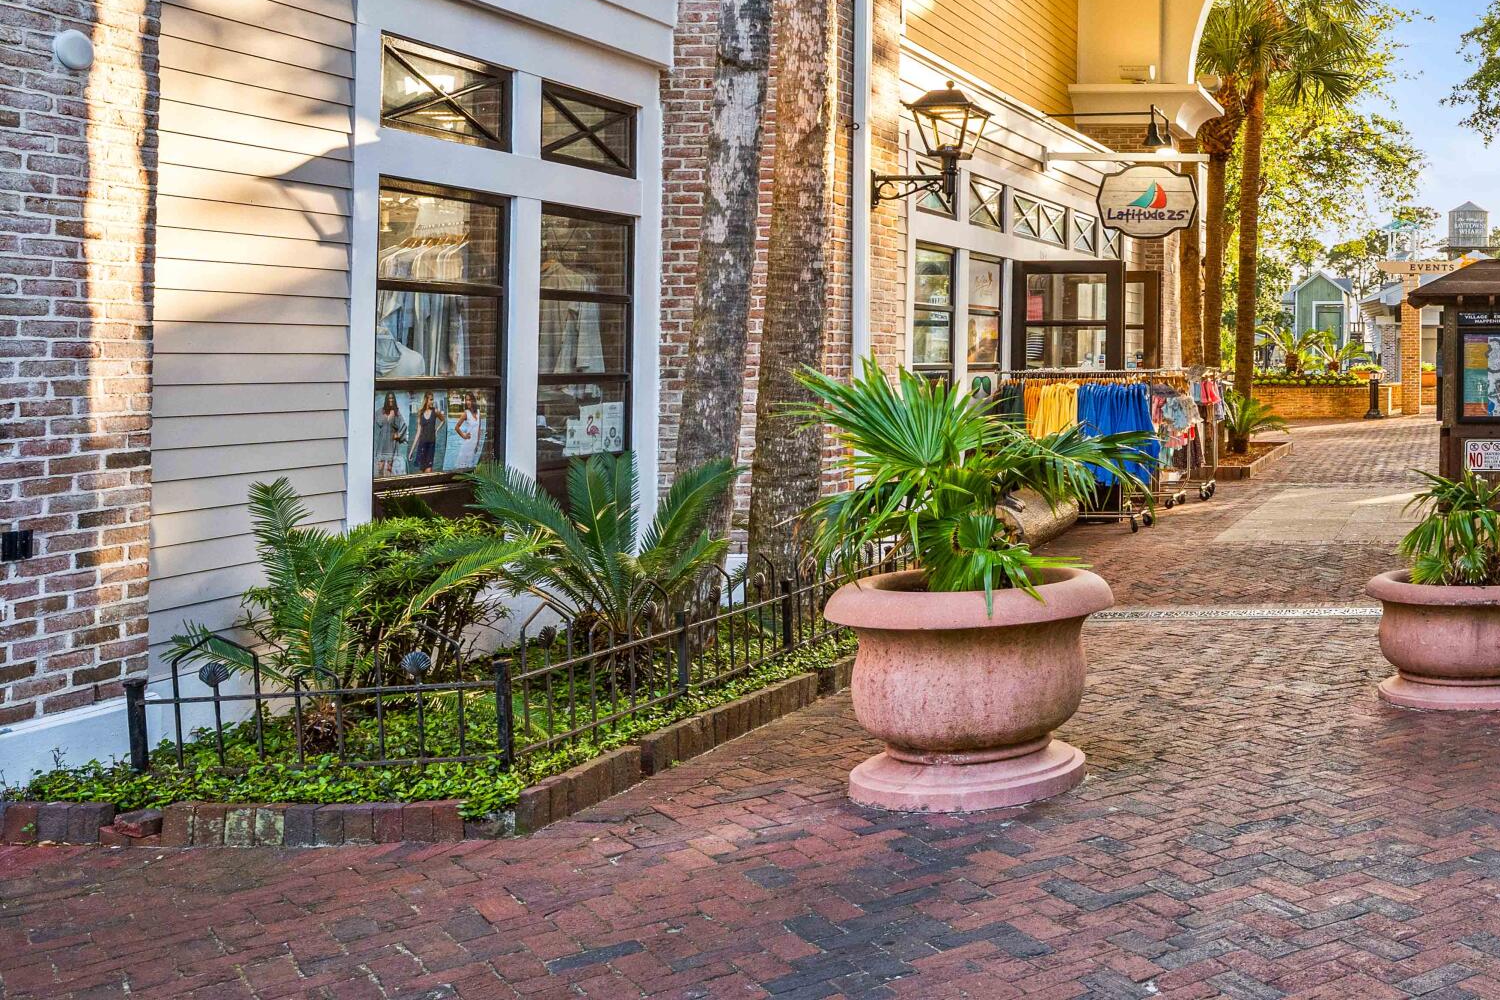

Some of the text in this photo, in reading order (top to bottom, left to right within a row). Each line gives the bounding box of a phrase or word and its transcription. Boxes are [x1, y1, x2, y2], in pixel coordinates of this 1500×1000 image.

[1107, 207, 1166, 223] Latitude
[1409, 263, 1455, 271] EVENTS
[1469, 452, 1483, 468] NO
